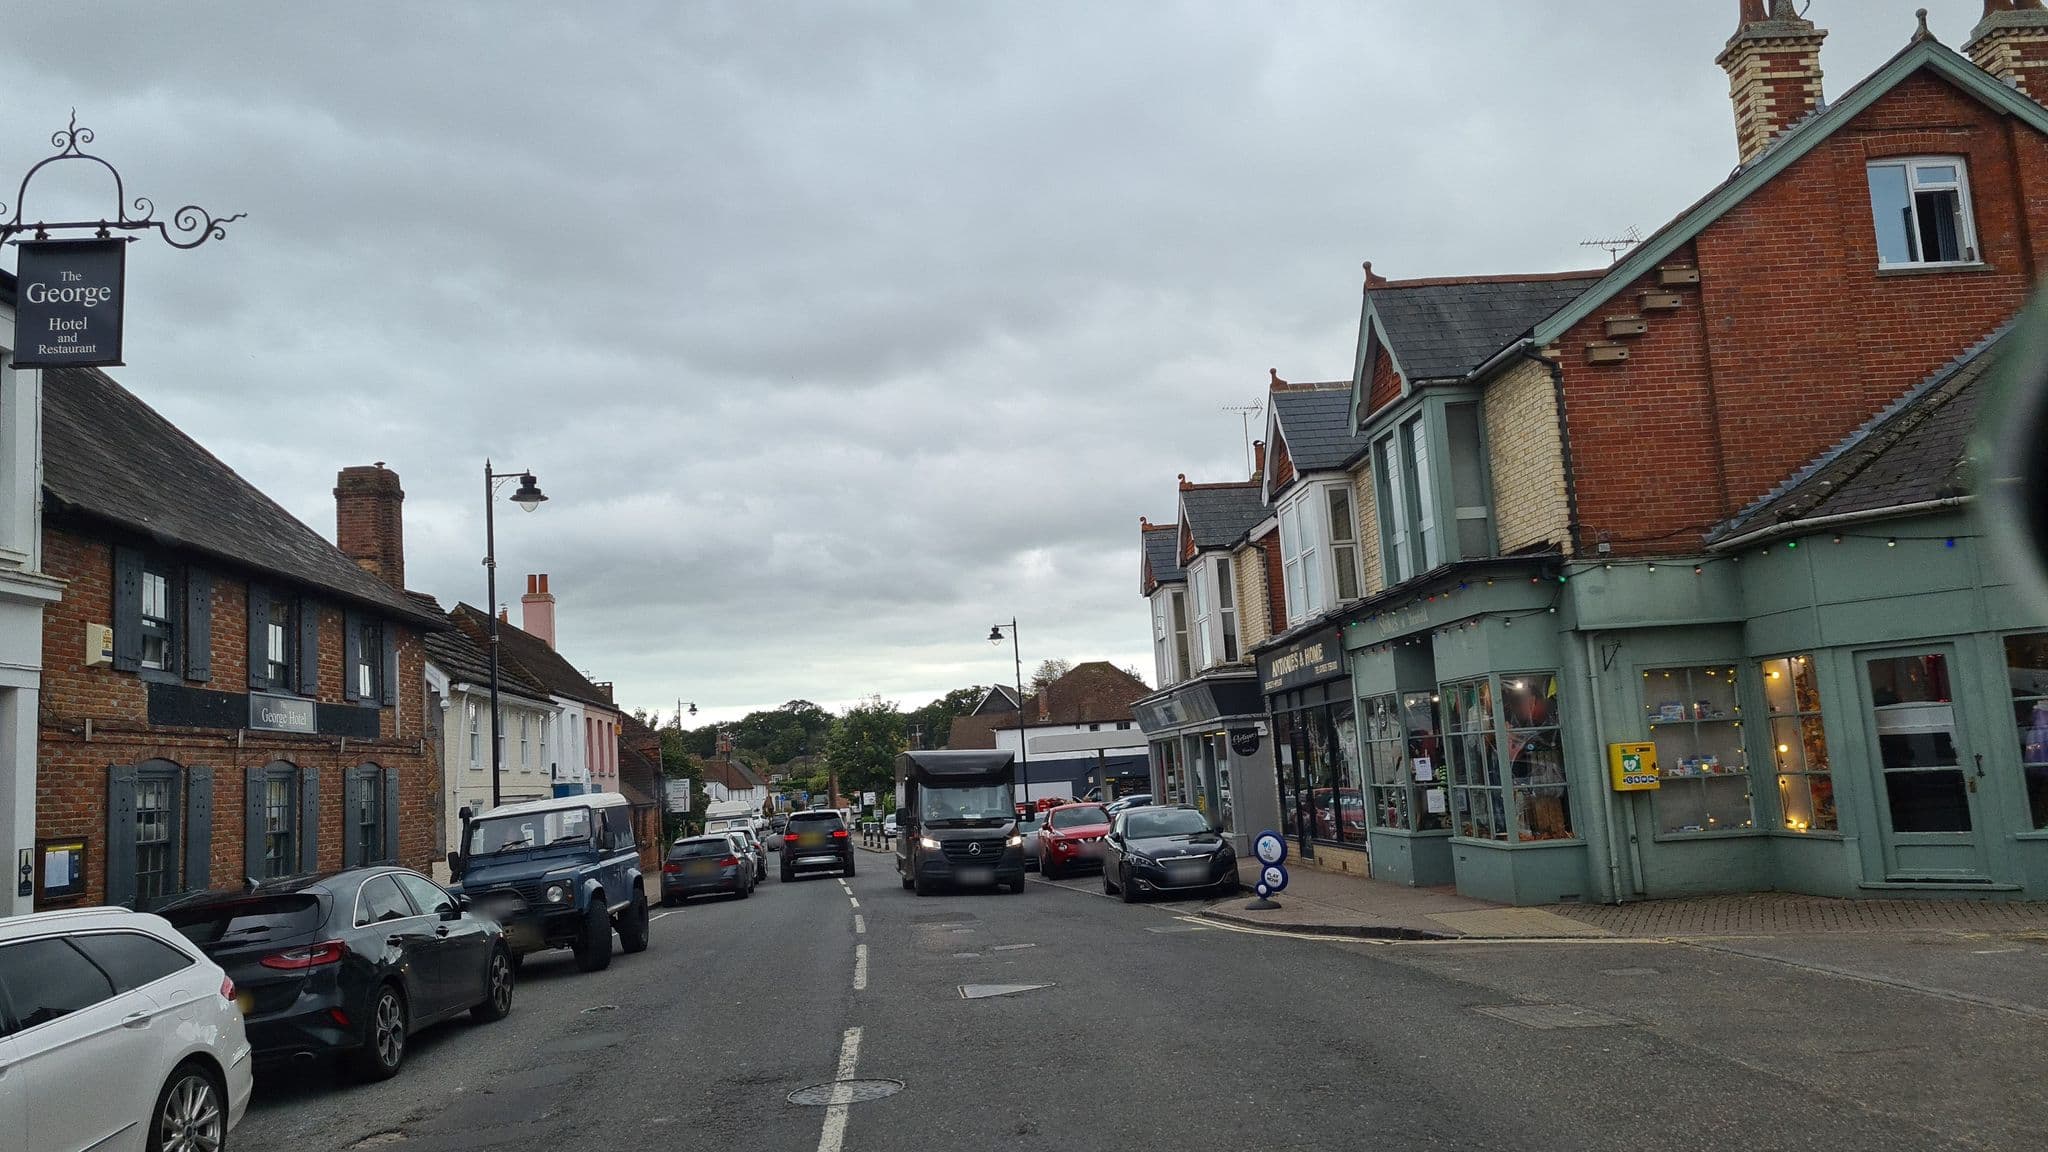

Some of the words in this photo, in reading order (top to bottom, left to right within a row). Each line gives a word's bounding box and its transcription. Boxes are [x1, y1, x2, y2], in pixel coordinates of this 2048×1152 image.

[60, 271, 82, 281] The
[26, 282, 111, 307] George
[49, 317, 88, 331] Hotel
[57, 332, 78, 343] and
[38, 344, 96, 354] Restaurant
[261, 707, 288, 727] George
[288, 711, 307, 726] Hotel
[1266, 871, 1279, 879] PLAY
